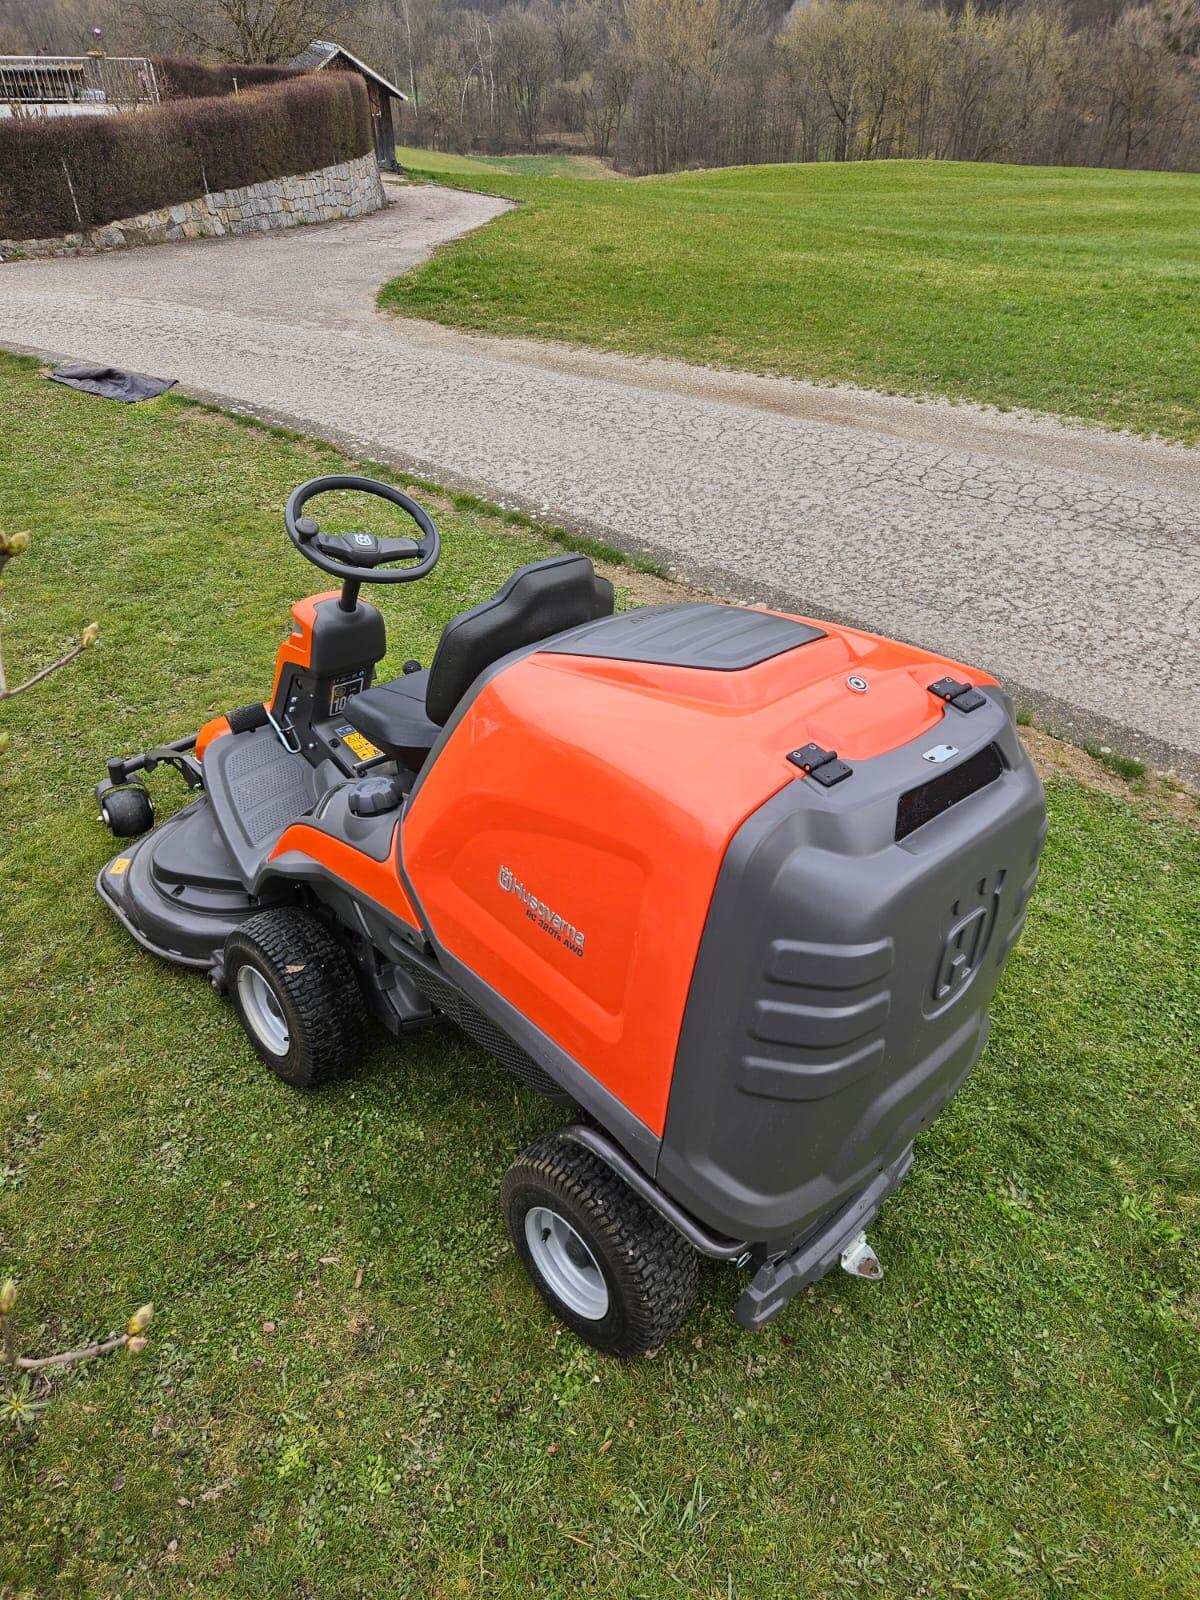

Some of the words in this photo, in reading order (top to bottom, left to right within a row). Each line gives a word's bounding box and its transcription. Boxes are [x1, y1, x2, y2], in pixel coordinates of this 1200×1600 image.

[512, 878, 585, 947] Husqvarna
[525, 909, 537, 922] RC
[563, 939, 584, 957] AWD
